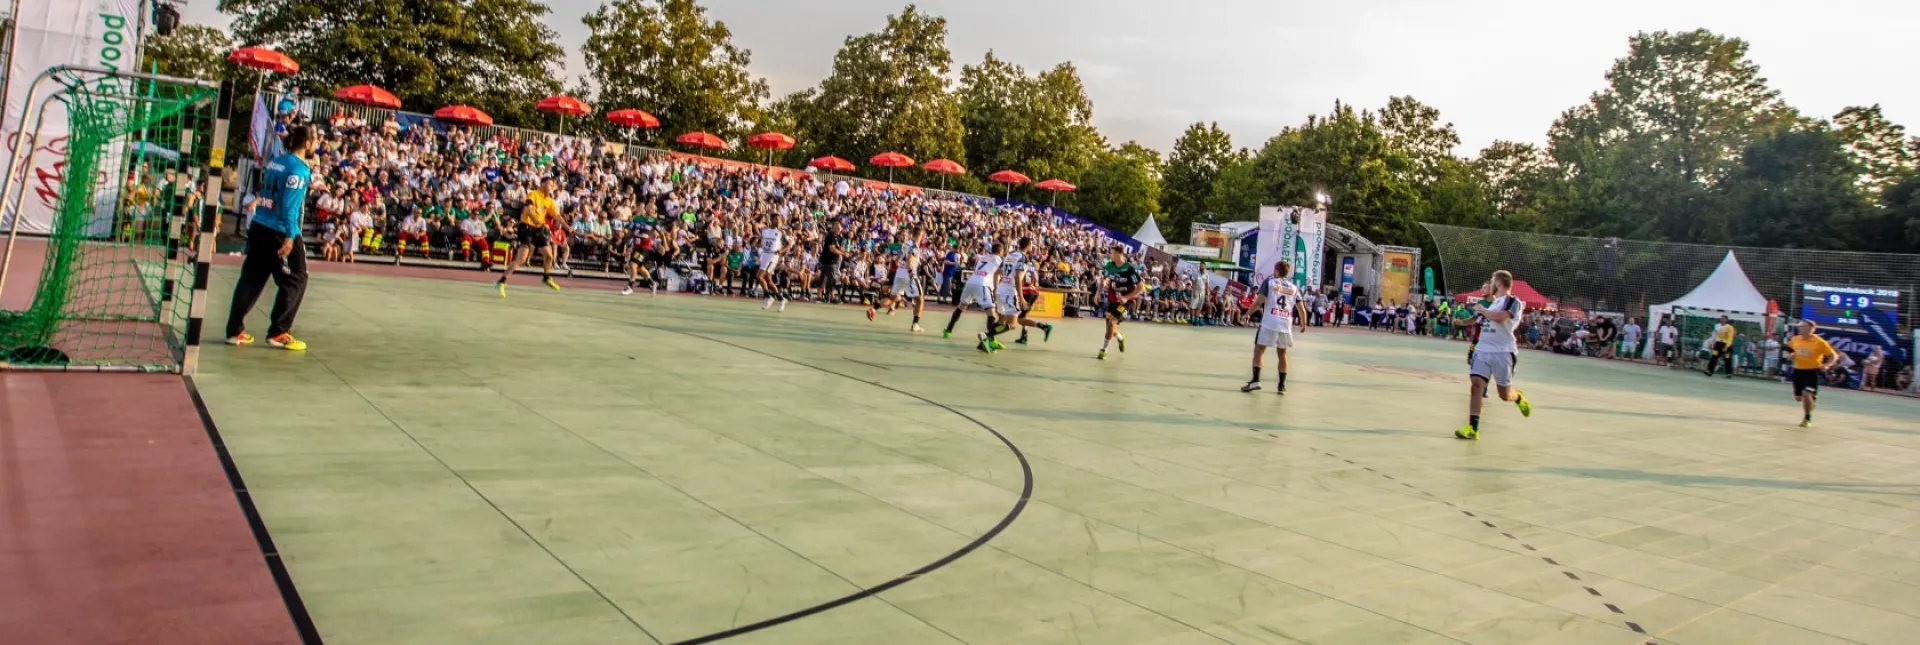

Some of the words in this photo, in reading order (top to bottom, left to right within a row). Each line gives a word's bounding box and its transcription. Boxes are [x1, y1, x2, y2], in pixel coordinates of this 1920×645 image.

[1312, 222, 1321, 285] megawood
[977, 261, 988, 270] 7
[1276, 295, 1287, 309] 4
[1830, 295, 1840, 304] 9
[1857, 297, 1869, 307] 9
